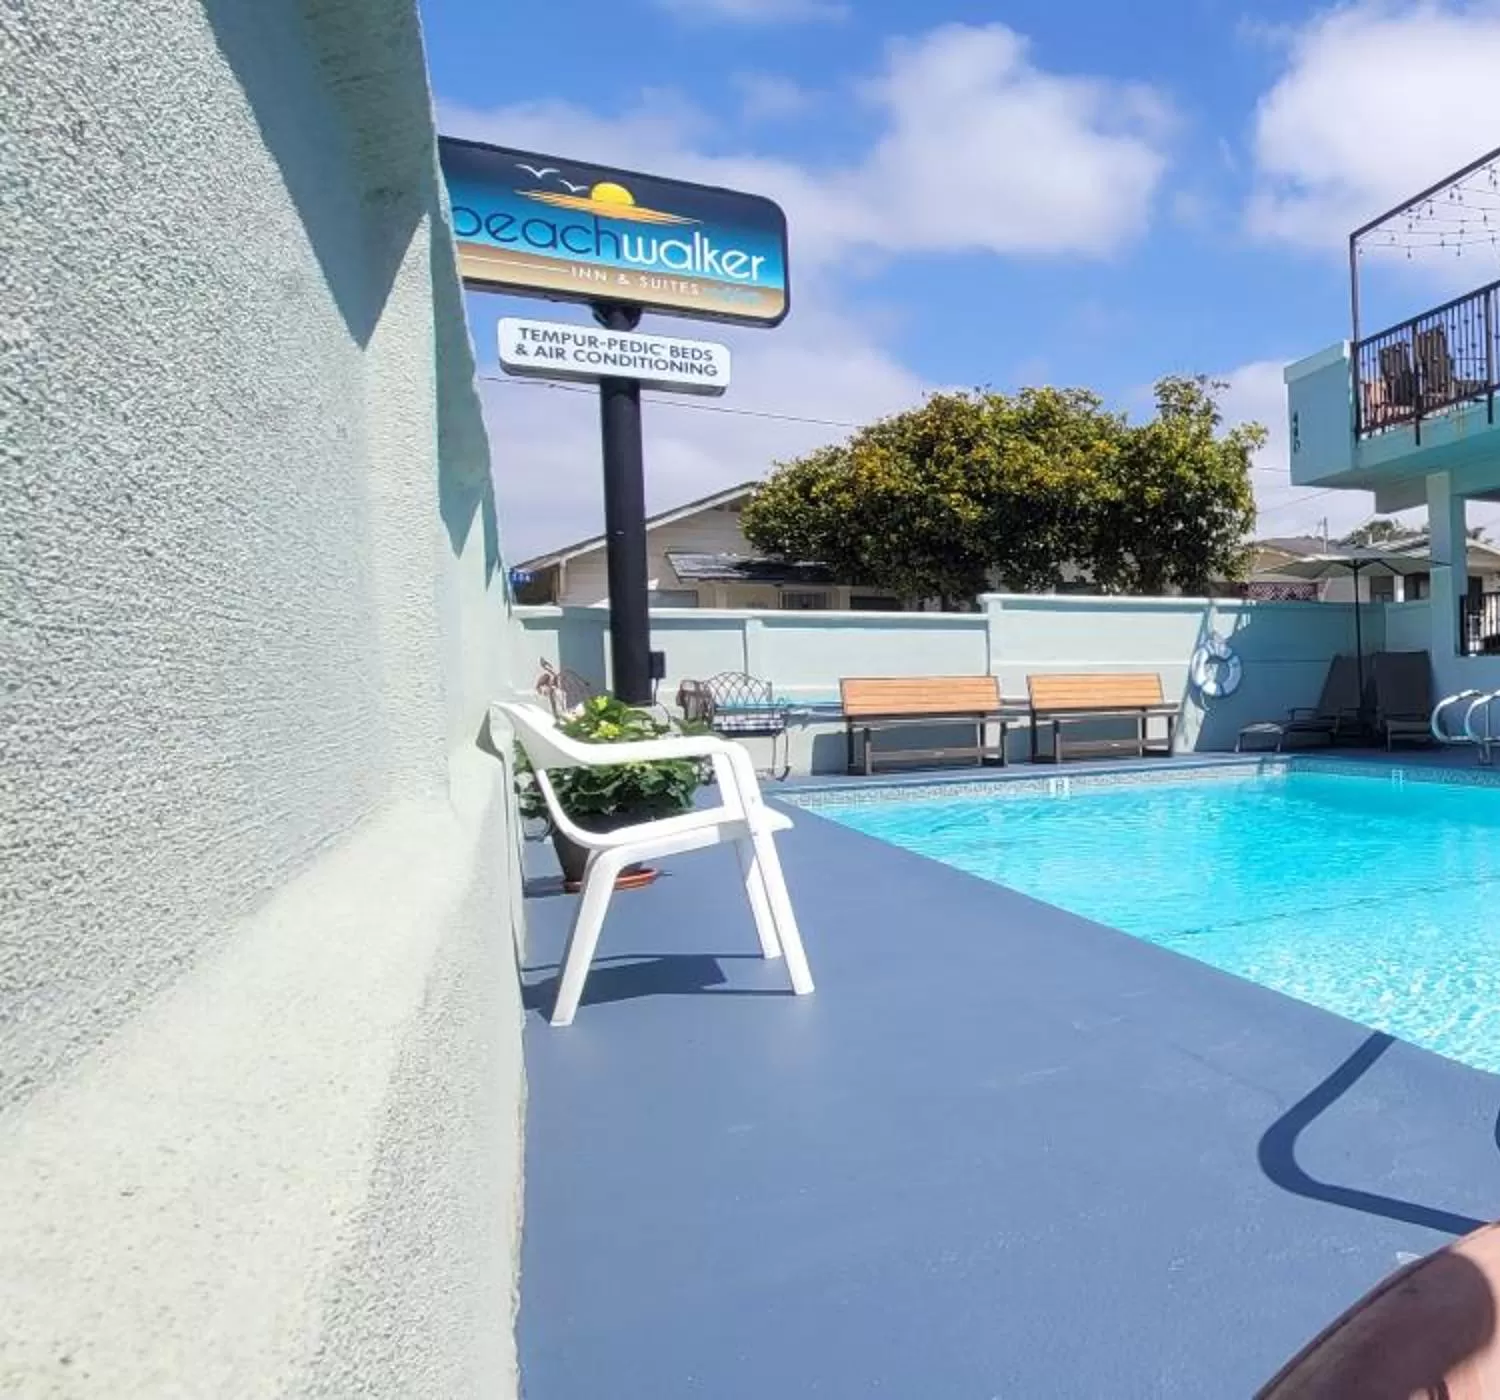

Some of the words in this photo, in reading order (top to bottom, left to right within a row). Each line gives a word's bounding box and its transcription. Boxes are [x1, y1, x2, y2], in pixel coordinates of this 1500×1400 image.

[571, 266, 608, 285] INN
[617, 273, 631, 287] &
[639, 275, 699, 297] SUITES
[515, 343, 529, 357] &
[534, 345, 567, 361] AIR
[573, 349, 718, 377] CONDITIONING
[669, 344, 714, 362] BEDS
